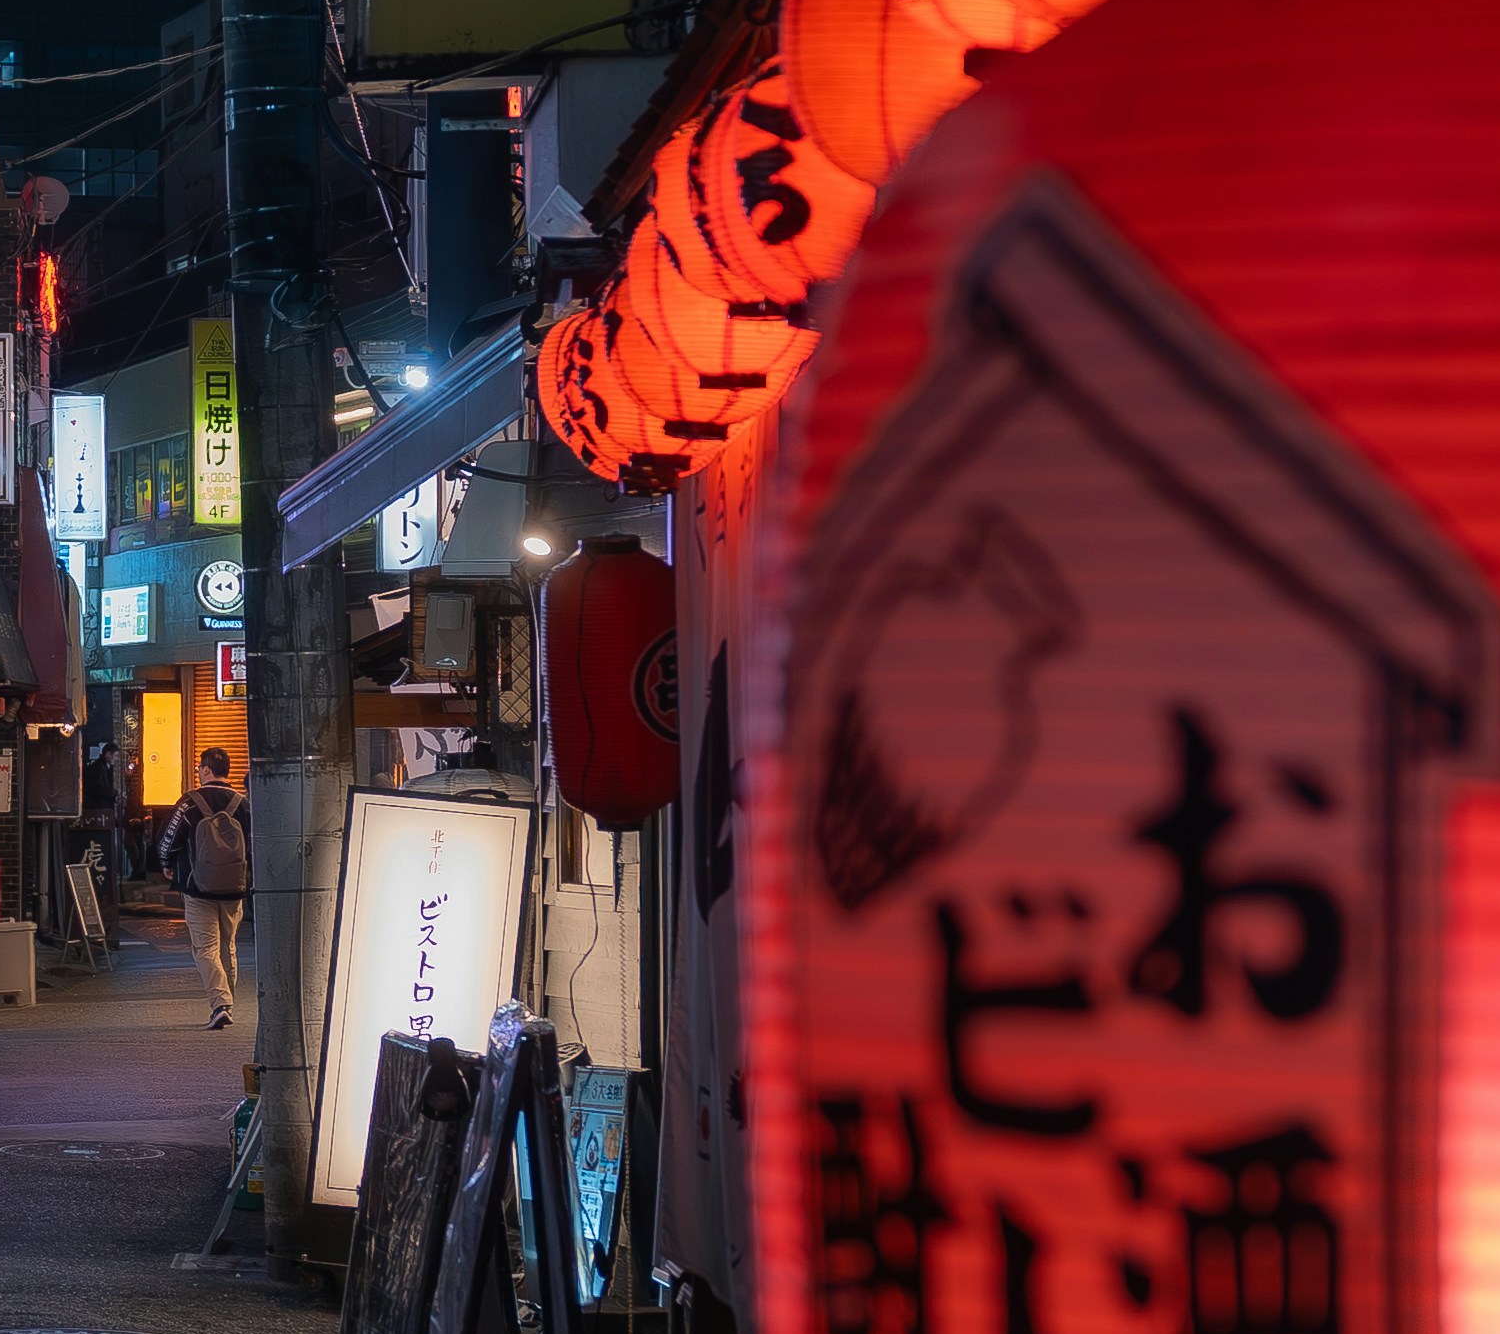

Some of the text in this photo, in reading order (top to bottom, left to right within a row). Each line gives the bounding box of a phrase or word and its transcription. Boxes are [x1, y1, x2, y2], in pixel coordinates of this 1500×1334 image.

[204, 370, 233, 466] 日焼け
[209, 504, 230, 519] 4F
